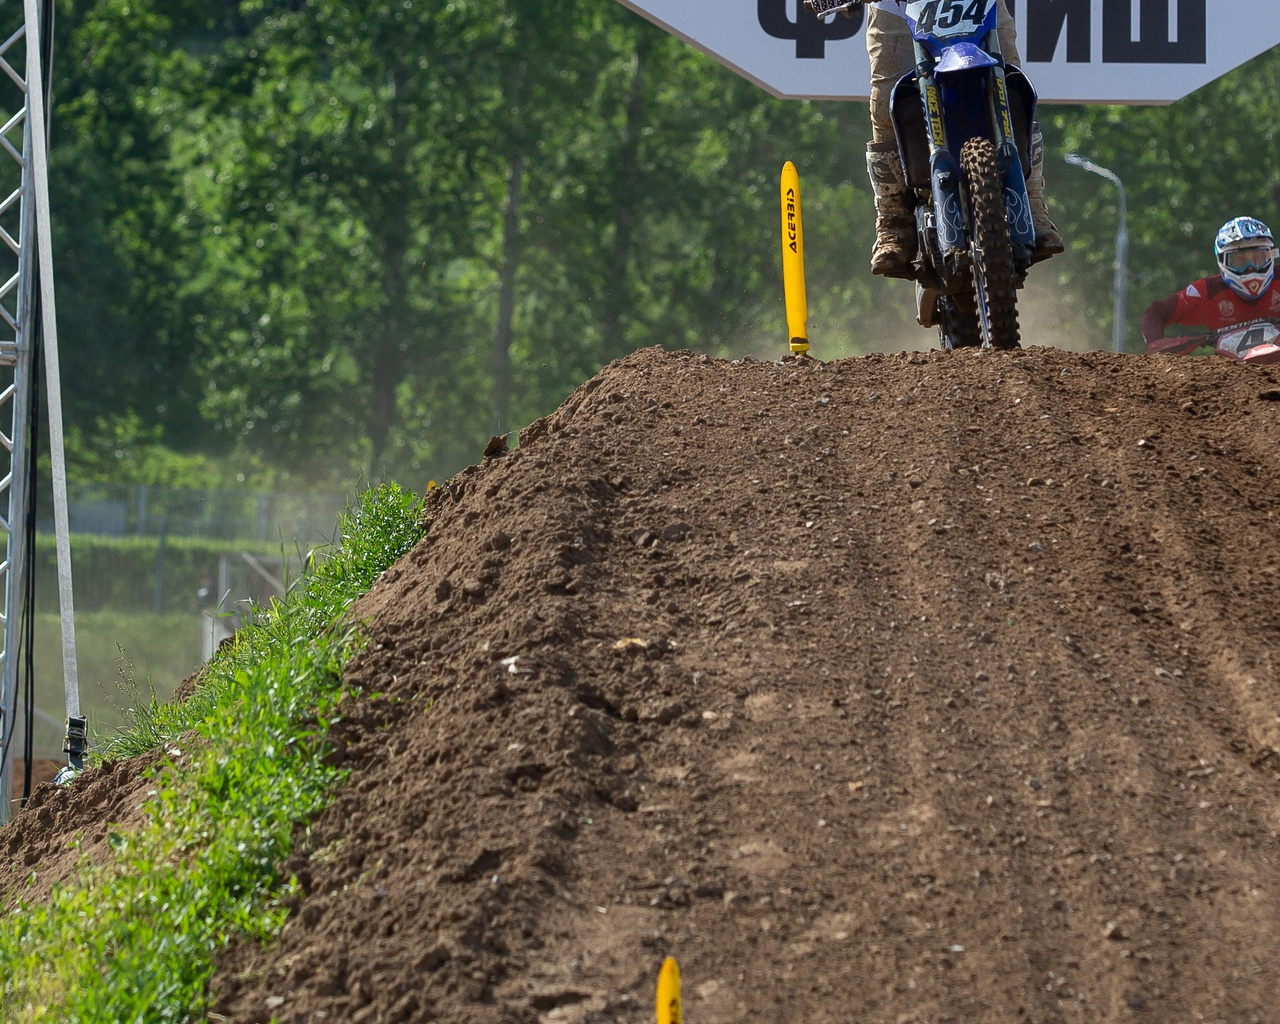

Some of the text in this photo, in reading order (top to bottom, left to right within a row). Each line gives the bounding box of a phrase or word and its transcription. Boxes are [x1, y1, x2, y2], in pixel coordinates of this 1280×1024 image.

[926, 85, 944, 146] RACE TECH
[786, 188, 798, 254] ACERBIS
[1236, 327, 1268, 354] 4
